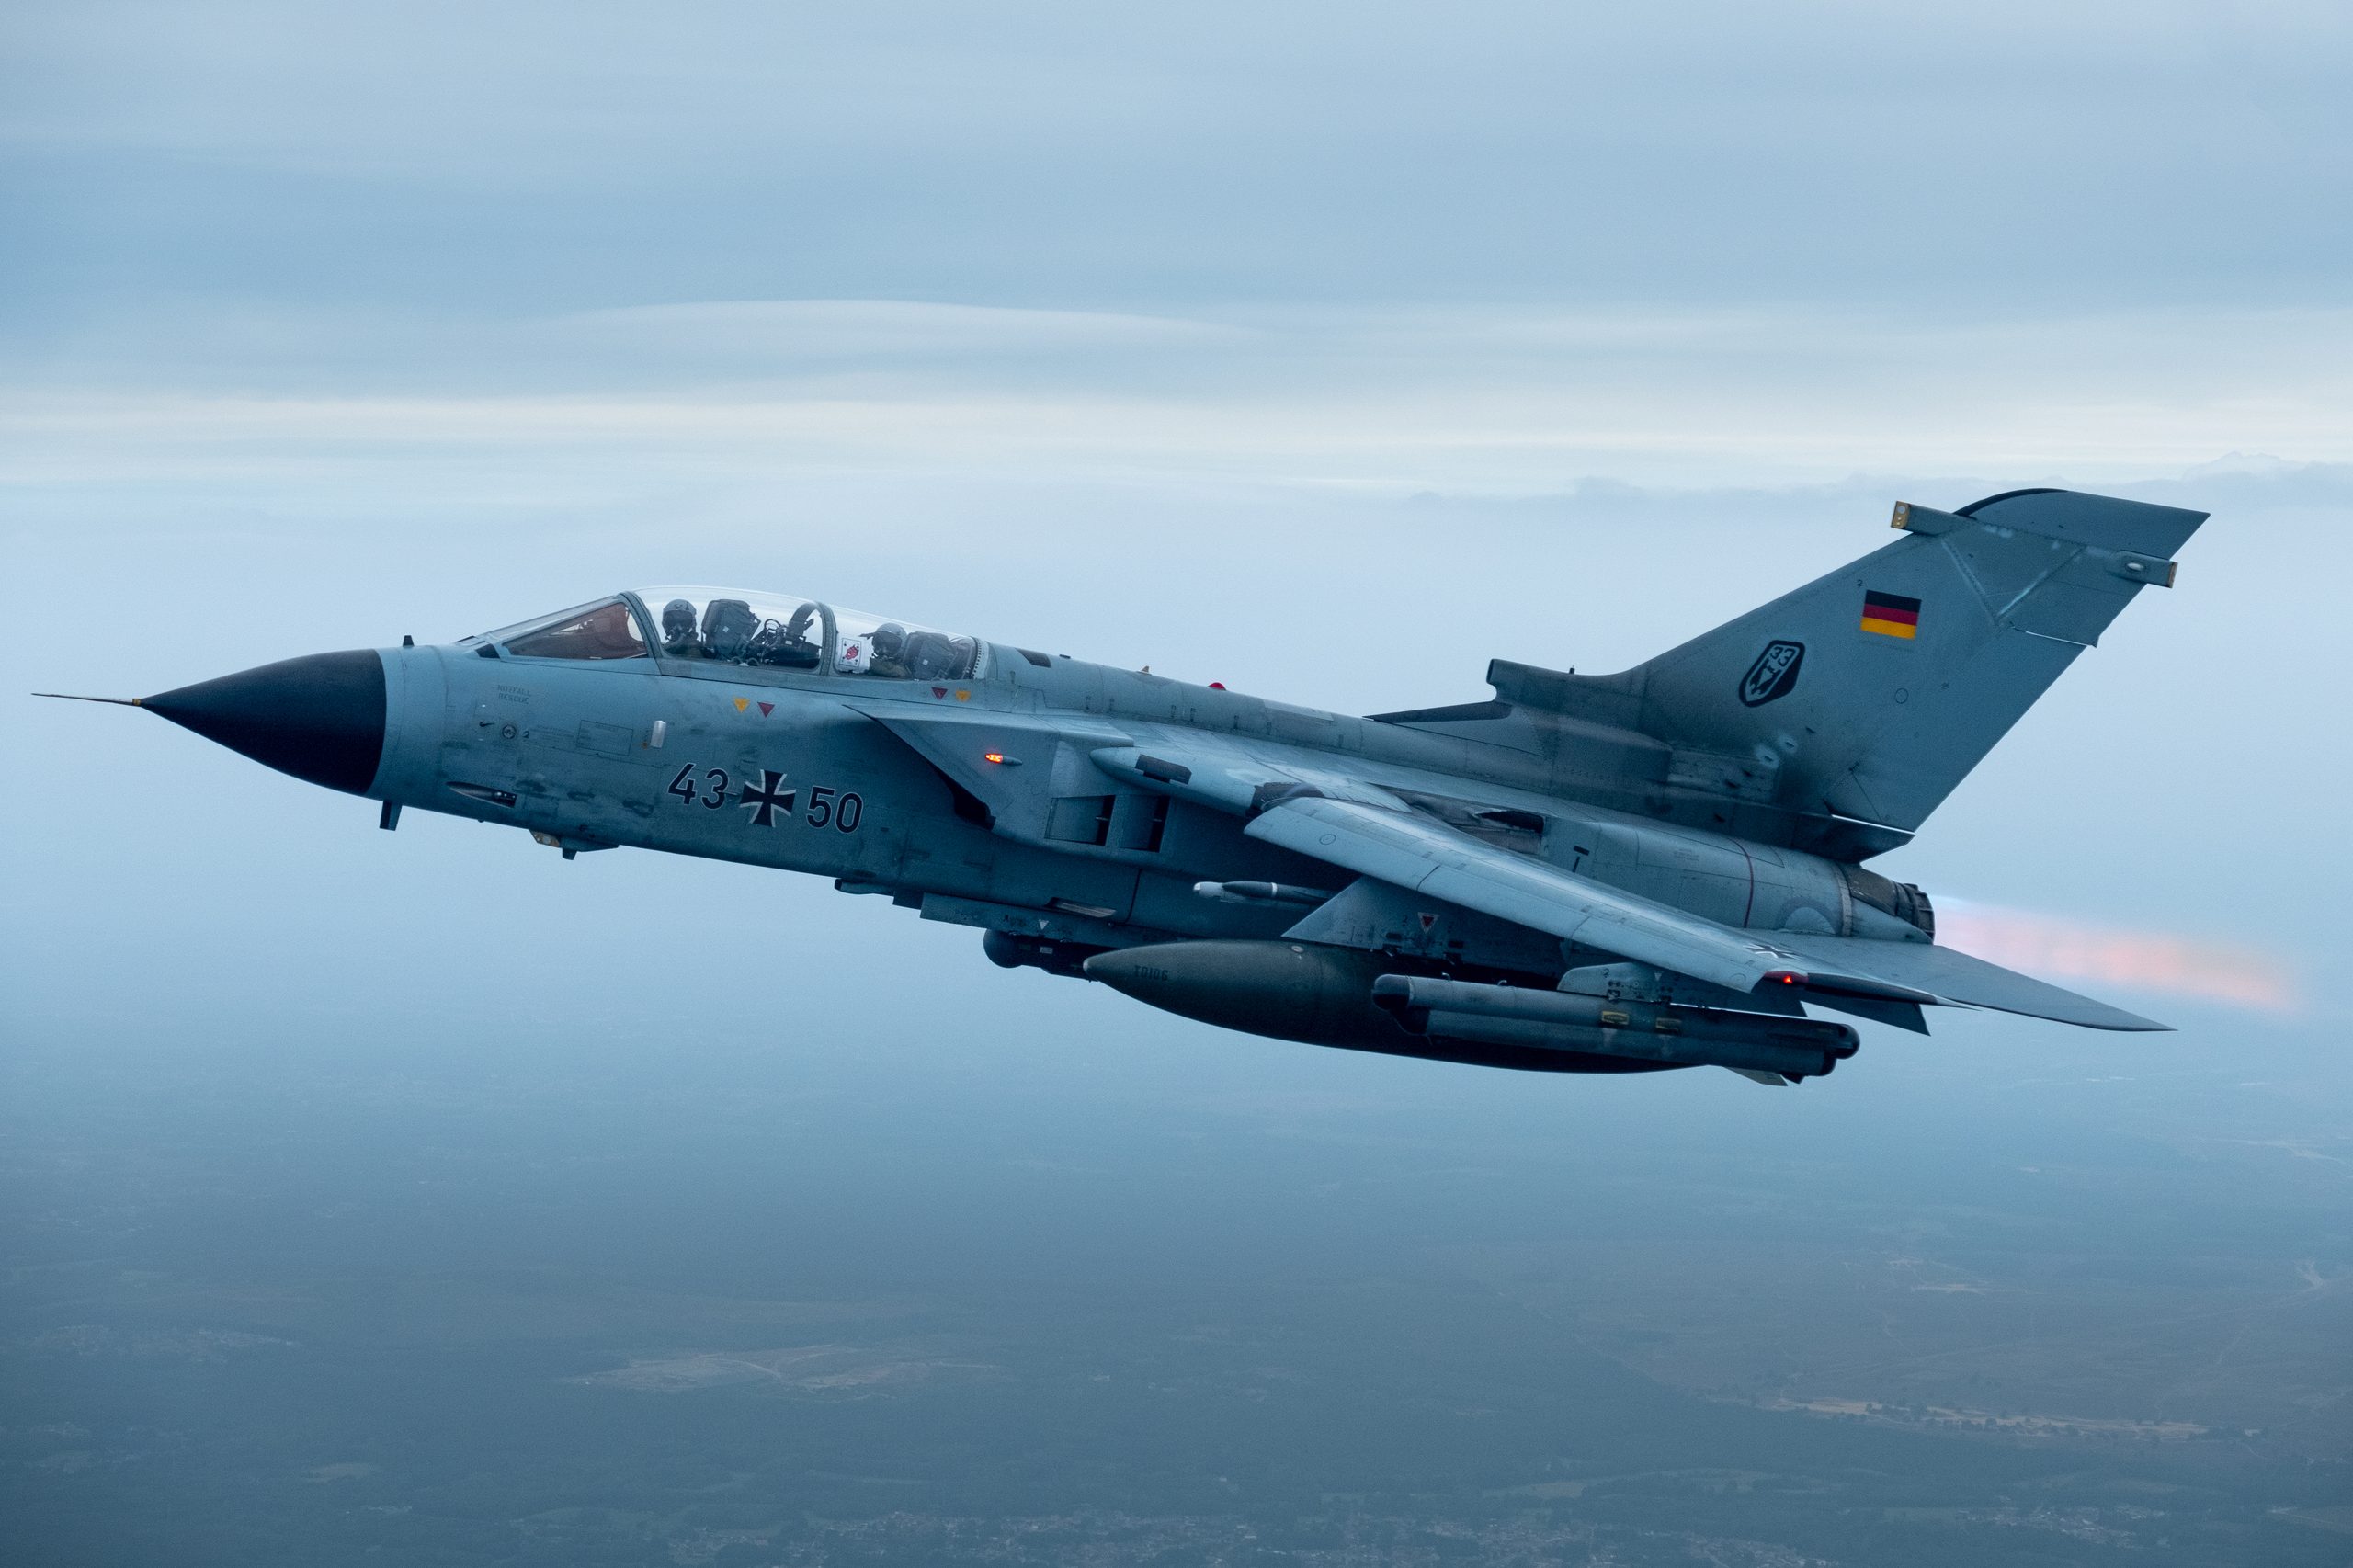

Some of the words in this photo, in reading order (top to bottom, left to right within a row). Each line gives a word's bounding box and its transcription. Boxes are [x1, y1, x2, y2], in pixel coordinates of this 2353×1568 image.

[1770, 645, 1797, 667] 33
[498, 692, 530, 705] RESCUE
[522, 730, 530, 739] 2
[668, 762, 729, 810] 43
[805, 785, 864, 834] 50
